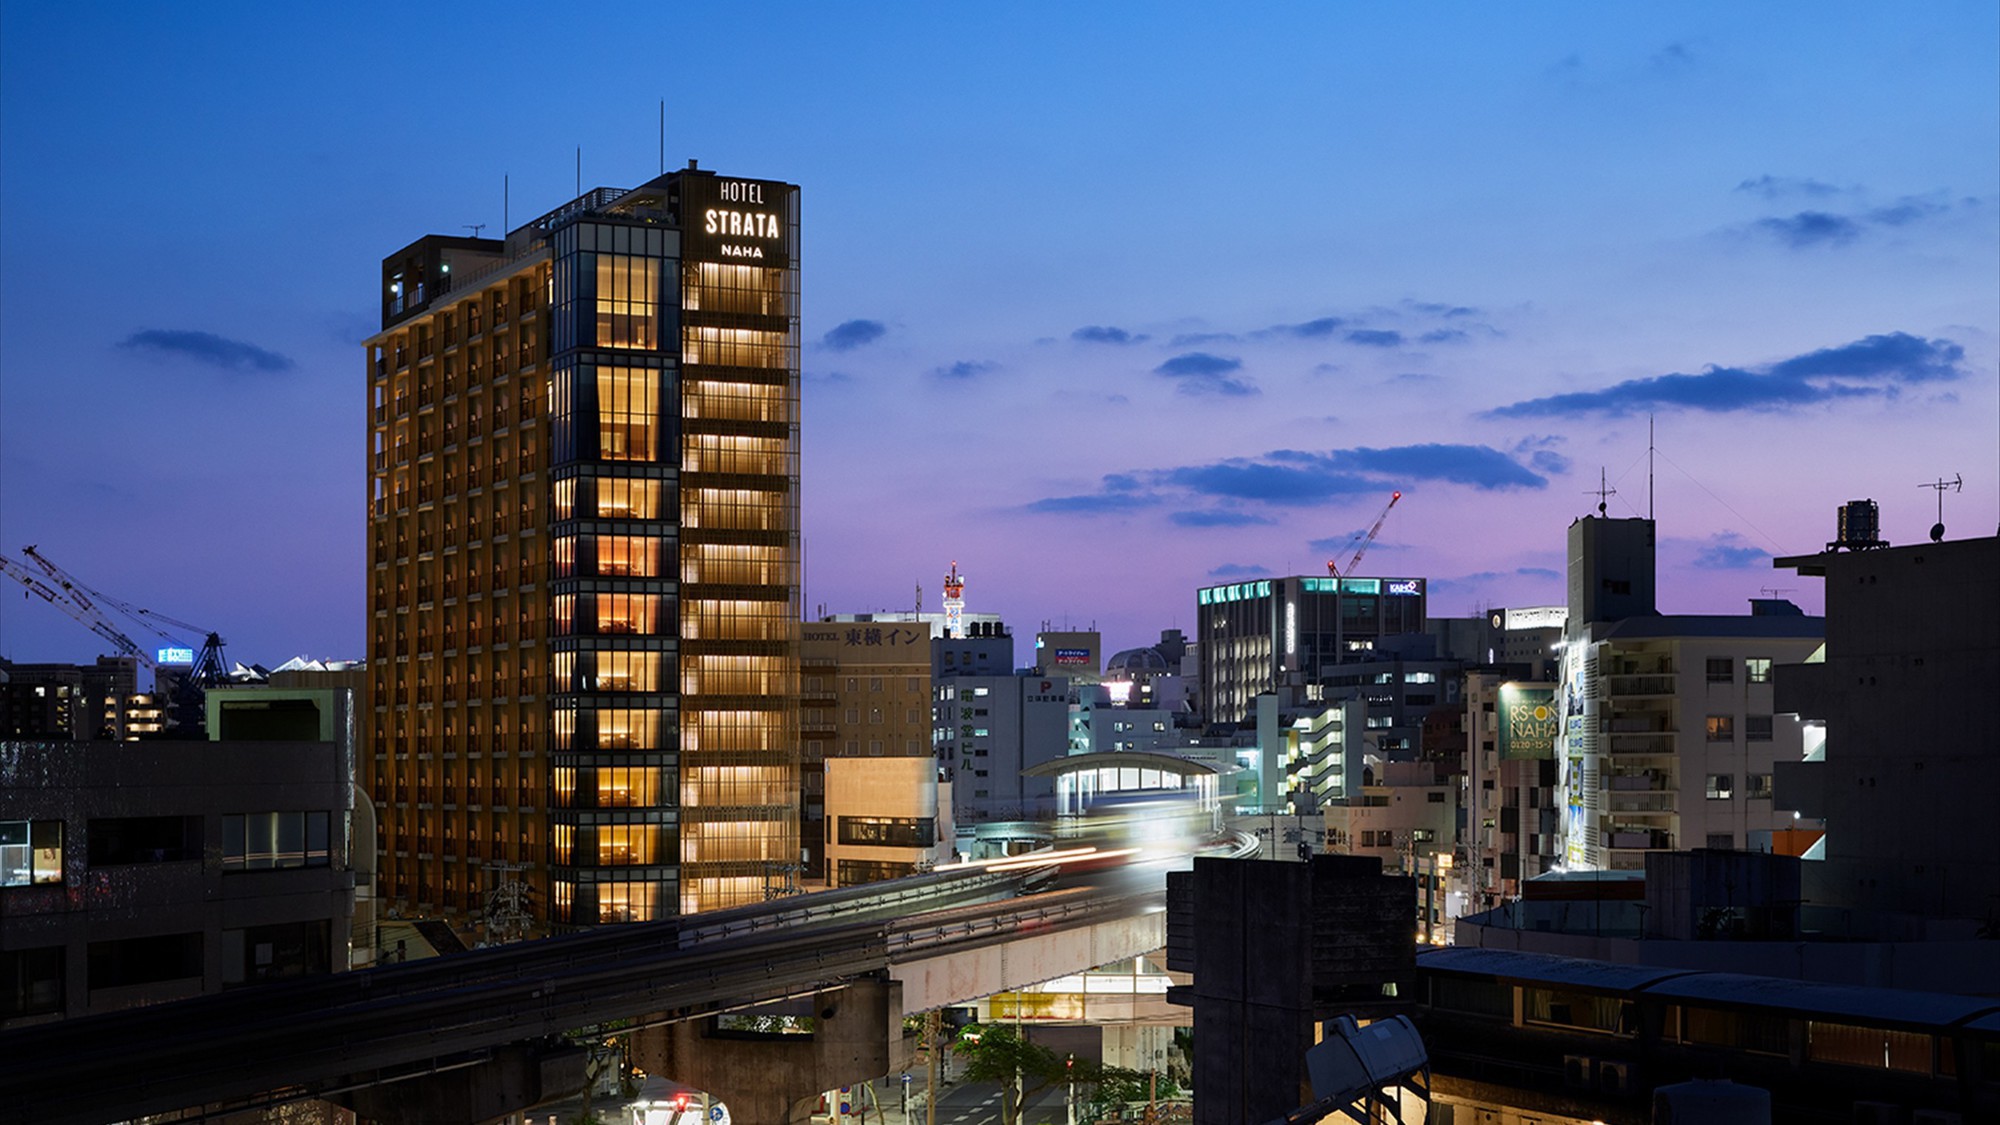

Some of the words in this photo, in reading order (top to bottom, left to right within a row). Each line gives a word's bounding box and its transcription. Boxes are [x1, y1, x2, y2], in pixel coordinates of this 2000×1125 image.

[720, 181, 764, 204] HOTEL
[705, 208, 779, 239] STRATA
[720, 244, 764, 259] NAHA
[803, 632, 840, 642] HOTEL
[844, 628, 921, 646] 東横イン
[1040, 681, 1053, 693] P
[1511, 722, 1558, 738] NAHA
